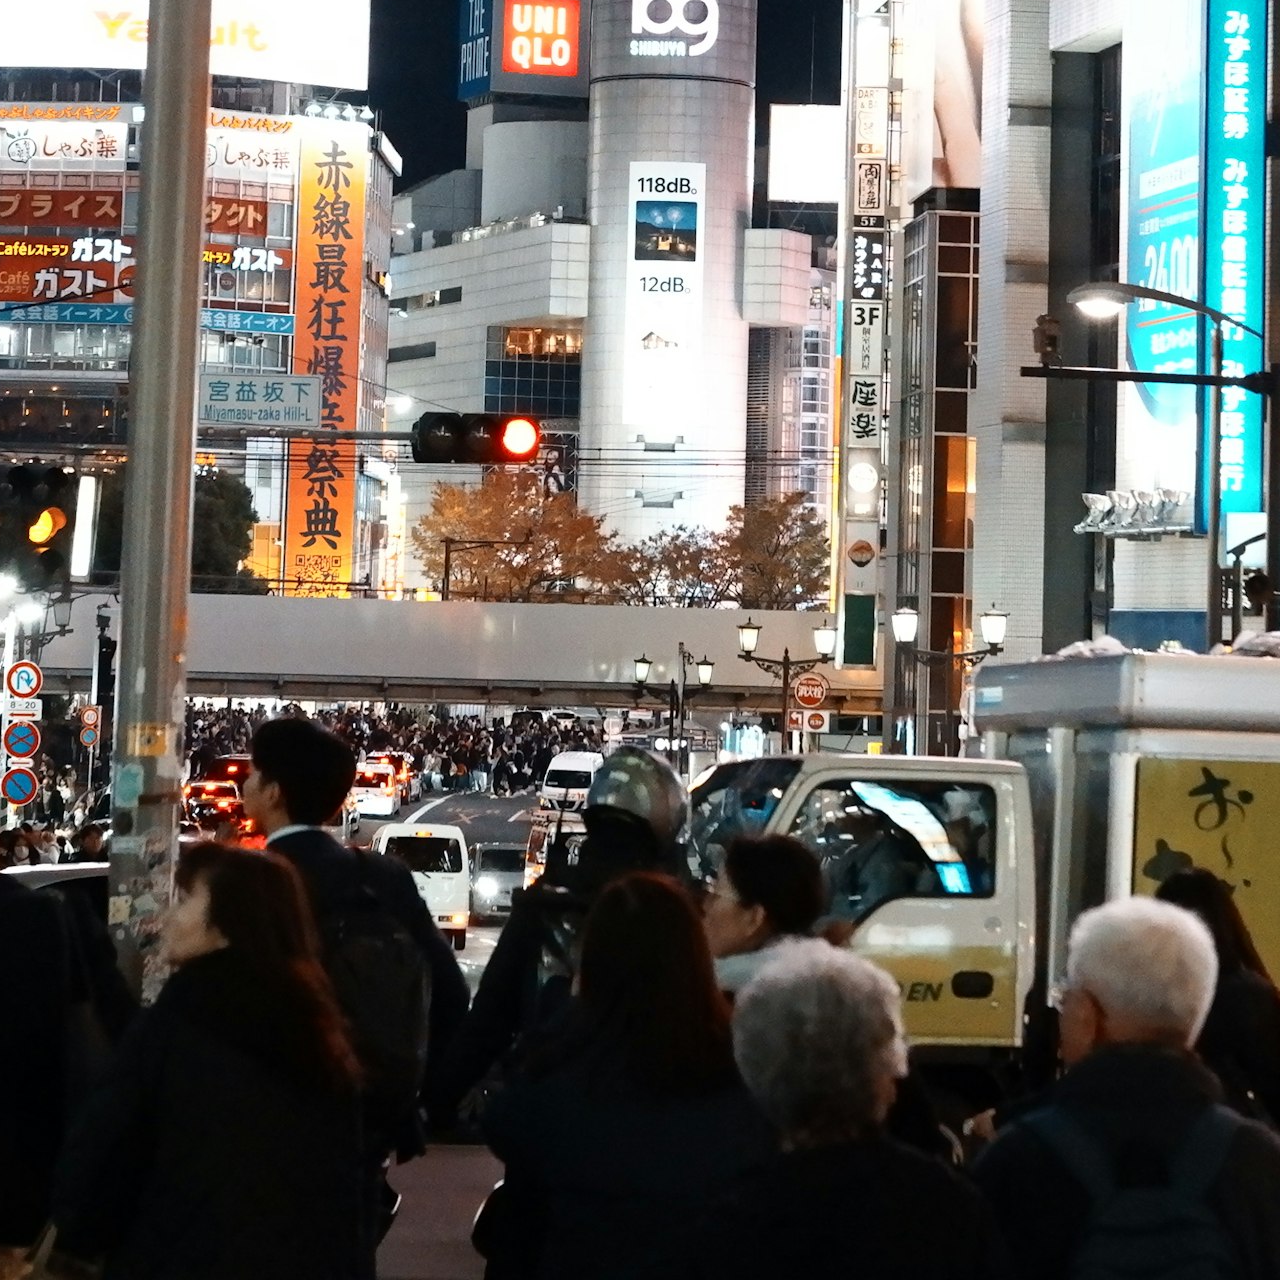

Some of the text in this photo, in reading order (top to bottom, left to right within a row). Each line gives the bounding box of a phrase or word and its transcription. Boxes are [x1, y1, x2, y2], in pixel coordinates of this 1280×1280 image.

[512, 3, 568, 36] UNI
[460, 35, 490, 84] PRIME
[511, 38, 571, 68] QLO
[43, 134, 117, 159] しゃぶ葉
[224, 142, 290, 169] しゃぶ葉
[205, 201, 263, 228] タクト
[860, 217, 877, 227] 5F
[71, 237, 132, 263] ガスト
[232, 247, 283, 272] ガスト
[854, 235, 868, 289] カラオケ
[871, 243, 882, 284] BAR
[32, 268, 107, 299] ガスト
[10, 305, 119, 321] 英会話イーオン
[200, 311, 292, 331] 英会話イーオン
[854, 307, 880, 326] 3F
[208, 381, 311, 404] 宮益坂下
[204, 404, 280, 422] Miyamasu-zaka
